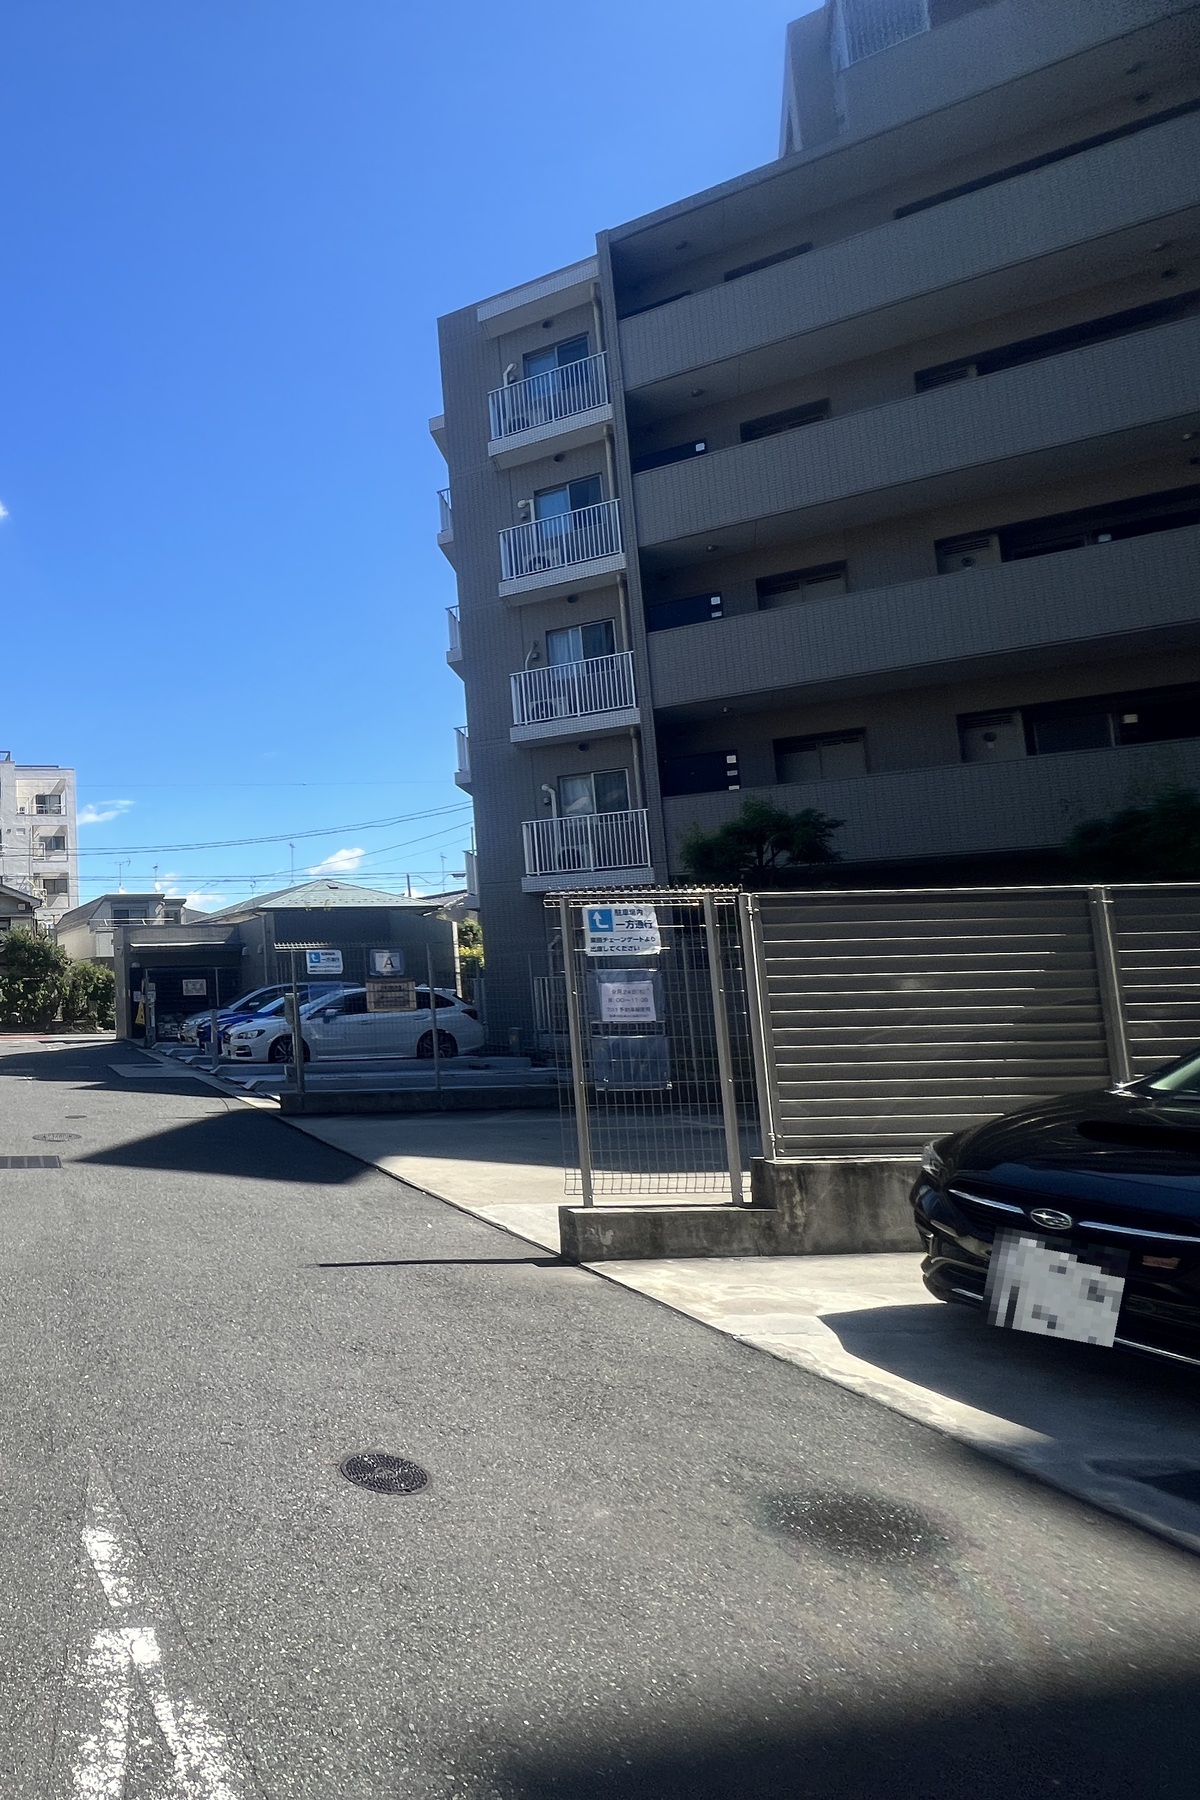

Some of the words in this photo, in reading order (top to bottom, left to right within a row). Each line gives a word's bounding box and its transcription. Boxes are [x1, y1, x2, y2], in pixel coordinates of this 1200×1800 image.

[615, 919, 653, 929] 一方通行
[383, 956, 394, 969] A
